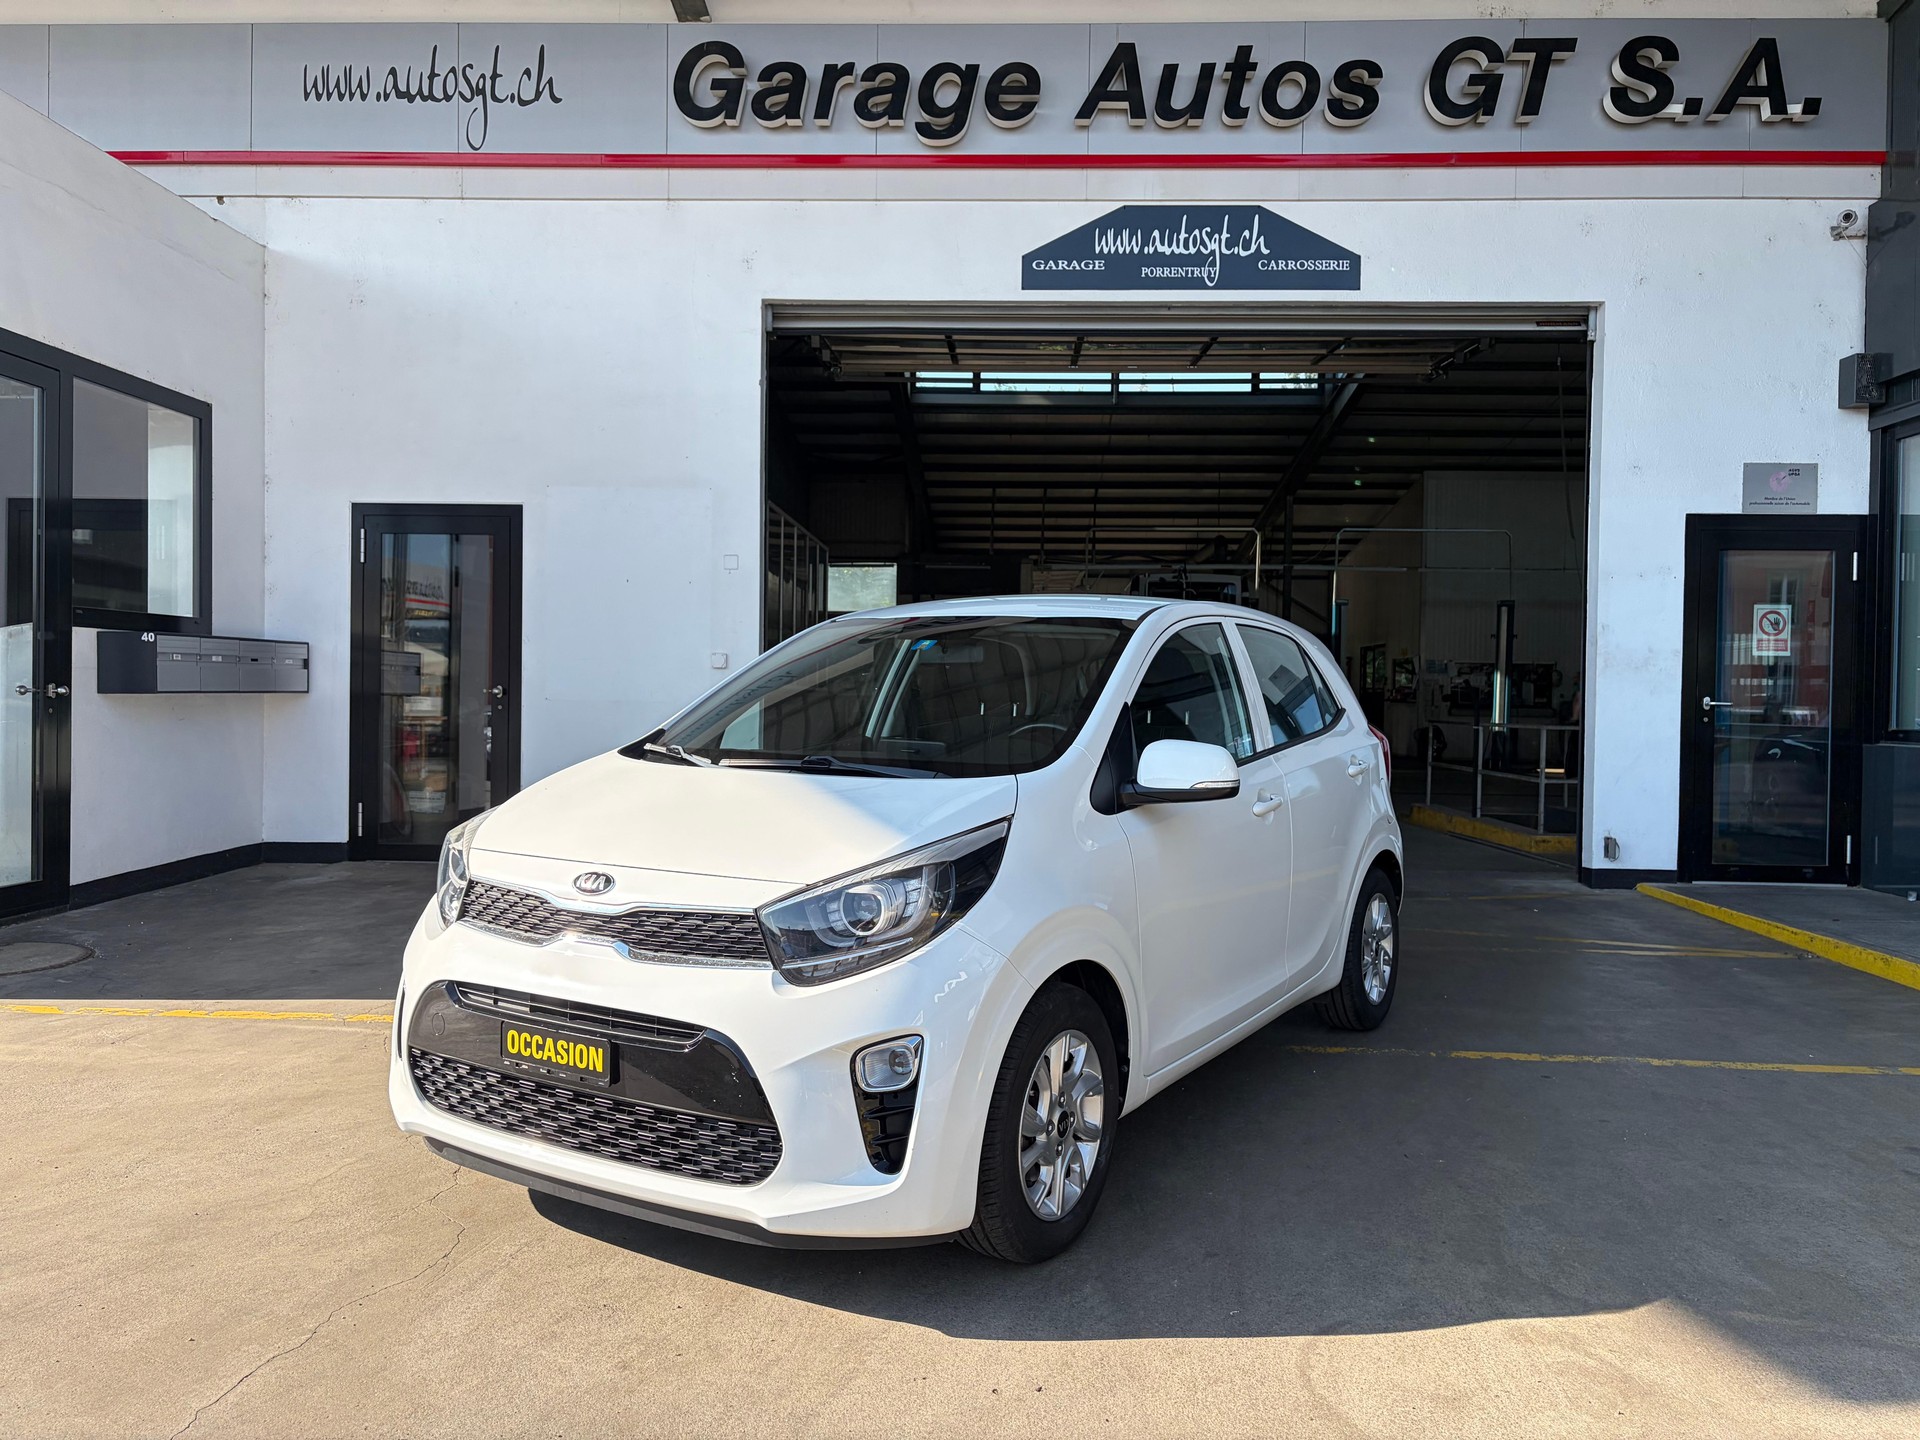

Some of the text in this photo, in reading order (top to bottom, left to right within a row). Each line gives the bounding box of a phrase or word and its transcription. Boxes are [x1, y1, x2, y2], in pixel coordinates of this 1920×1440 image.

[303, 44, 563, 151] www.autosgt.ch
[673, 35, 1823, 146] Garage Autos GT S.A.
[1032, 259, 1350, 271] GARAGE CARROSSERIE
[1095, 214, 1270, 286] www.autosgt.ch
[1141, 266, 1217, 278] PORRENTRUY
[141, 632, 155, 642] 40
[575, 873, 607, 891] KIA
[507, 1029, 603, 1073] OCCASION
